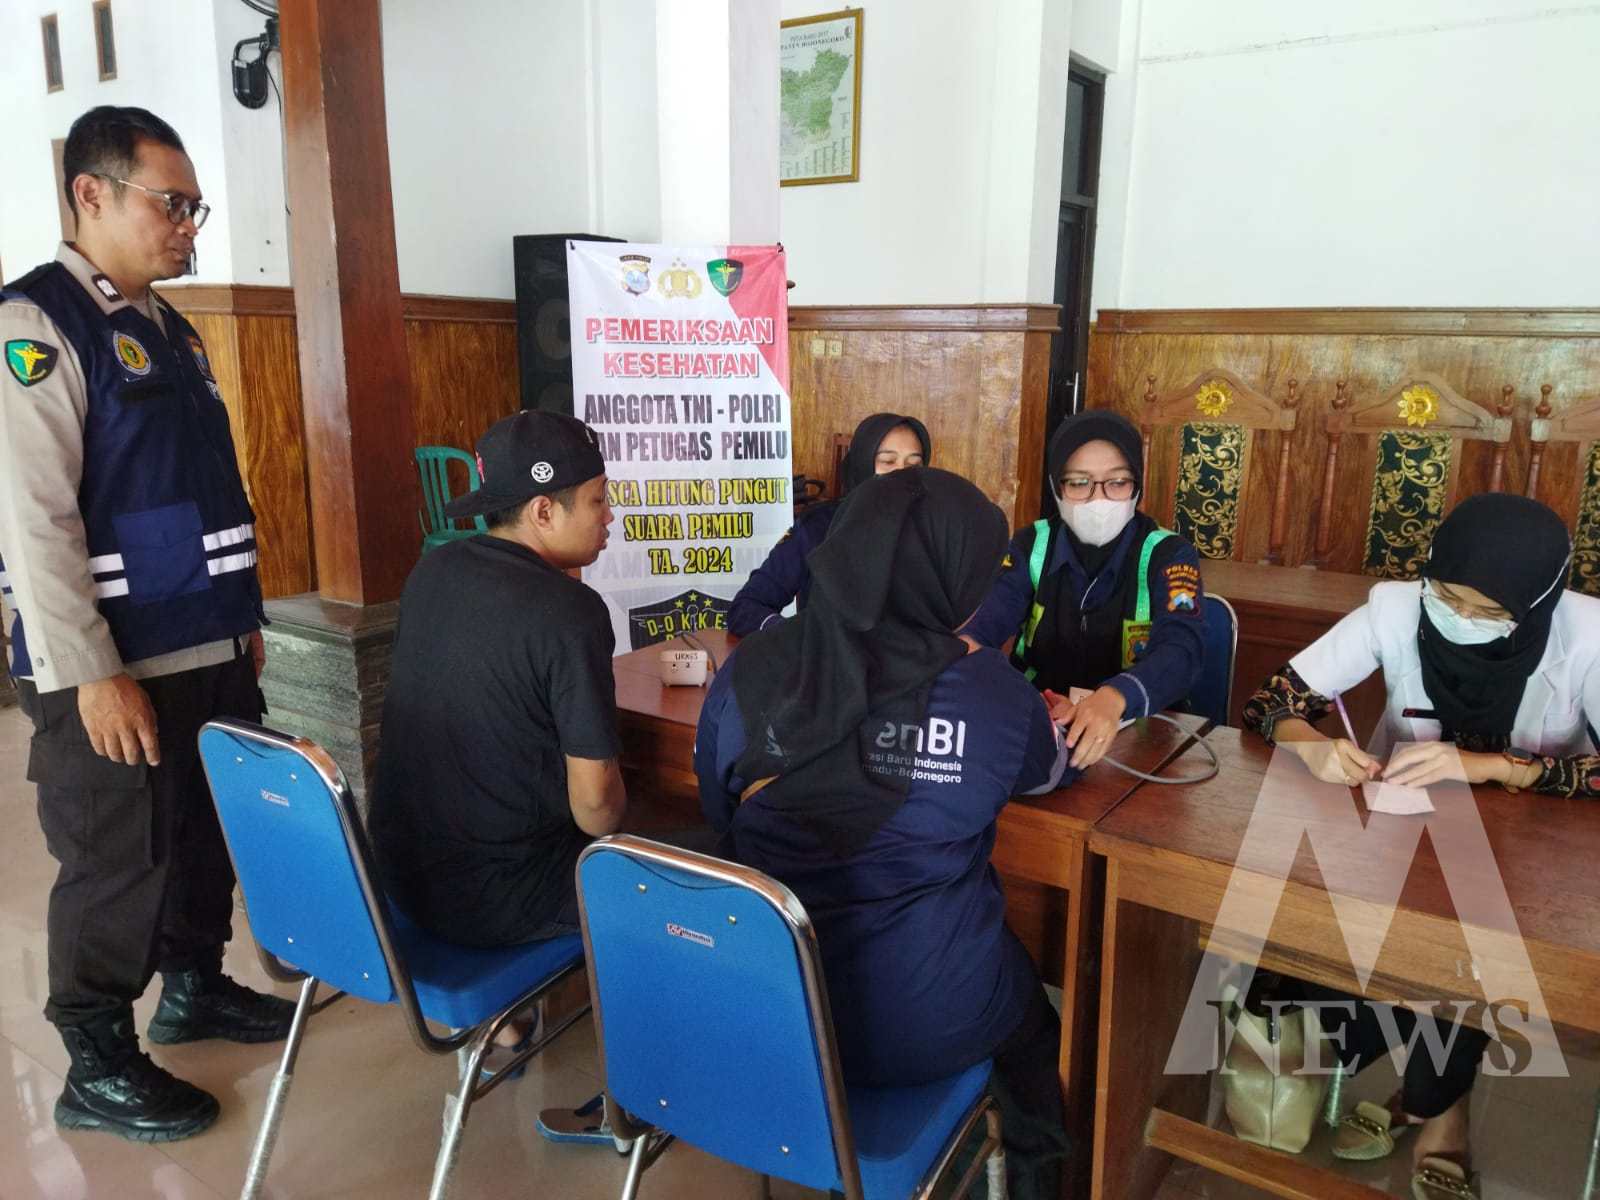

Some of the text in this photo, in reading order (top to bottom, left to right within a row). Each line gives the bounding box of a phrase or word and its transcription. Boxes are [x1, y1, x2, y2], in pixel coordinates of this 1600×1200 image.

[585, 318, 773, 343] PEMERIKSAAN
[603, 352, 758, 376] KESEHATAN
[584, 394, 677, 424] ANGGOTA
[681, 394, 712, 423] TNI
[729, 394, 781, 423] POLRI
[599, 431, 787, 461] AN PETUGAS PEMILU
[607, 478, 788, 506] SCA HITUNG PUNGUT
[624, 512, 753, 541] SUARA PEMILU
[649, 549, 679, 575] TA.
[684, 546, 733, 574] 2024
[914, 757, 962, 772] Indonesia
